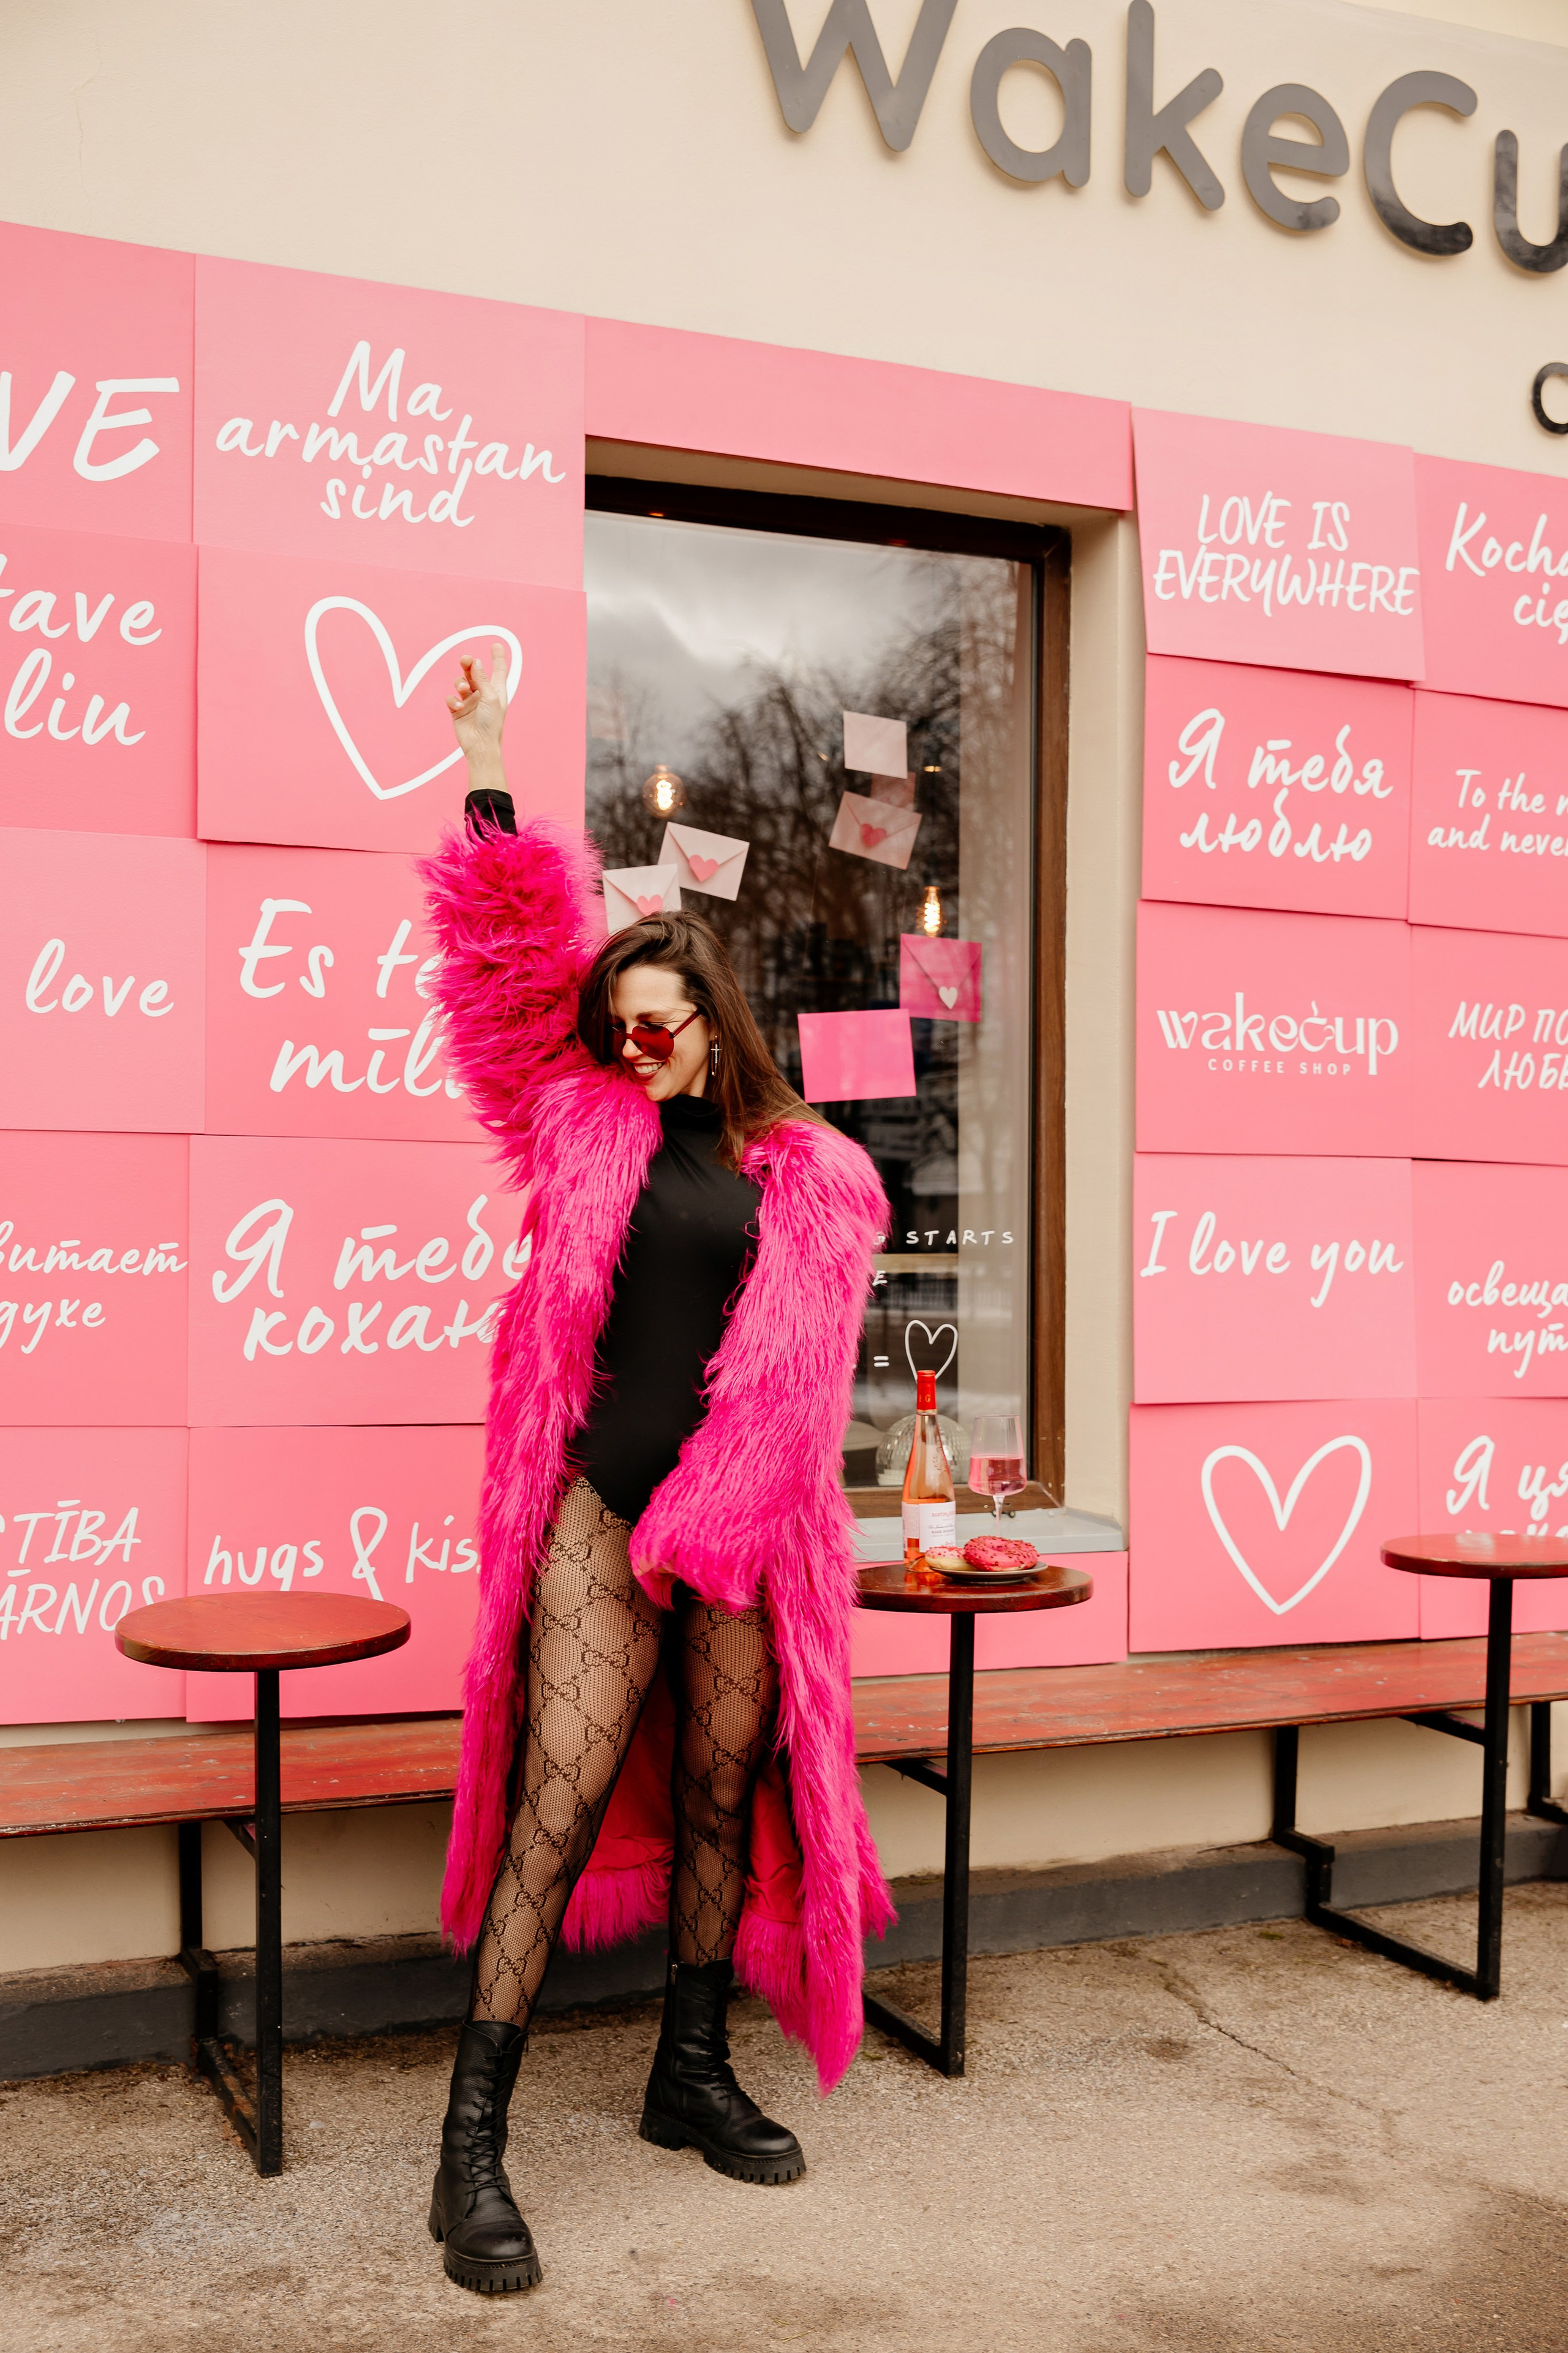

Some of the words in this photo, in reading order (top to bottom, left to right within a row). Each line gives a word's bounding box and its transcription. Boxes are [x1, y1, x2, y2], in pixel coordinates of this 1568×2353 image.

[327, 339, 453, 423] Ma
[216, 414, 567, 485] armastan
[320, 457, 475, 528] sind
[1197, 490, 1292, 550] LOVE
[1307, 500, 1351, 552] IS
[1153, 544, 1420, 618] EVERYWHERE
[1168, 708, 1226, 790] Я
[1247, 723, 1393, 799] тебя
[1179, 787, 1373, 863] люблю
[1455, 768, 1487, 809] To
[1497, 772, 1547, 814] the
[1427, 812, 1491, 852] and
[1499, 831, 1568, 857] neve
[25, 938, 175, 1018] love
[238, 897, 335, 999] Es
[1447, 1000, 1526, 1041] МИР
[1207, 1057, 1286, 1073] COFFEE
[1298, 1062, 1351, 1076] SHOP
[211, 1198, 295, 1304] Я
[905, 1229, 1015, 1246] STARTS
[1139, 1210, 1178, 1278] I
[1188, 1210, 1291, 1276] love
[1309, 1239, 1404, 1309] you
[1446, 1434, 1496, 1515] Я
[0, 1499, 142, 1566] TĪBA
[203, 1534, 325, 1592] hugs
[404, 1514, 483, 1584] kis
